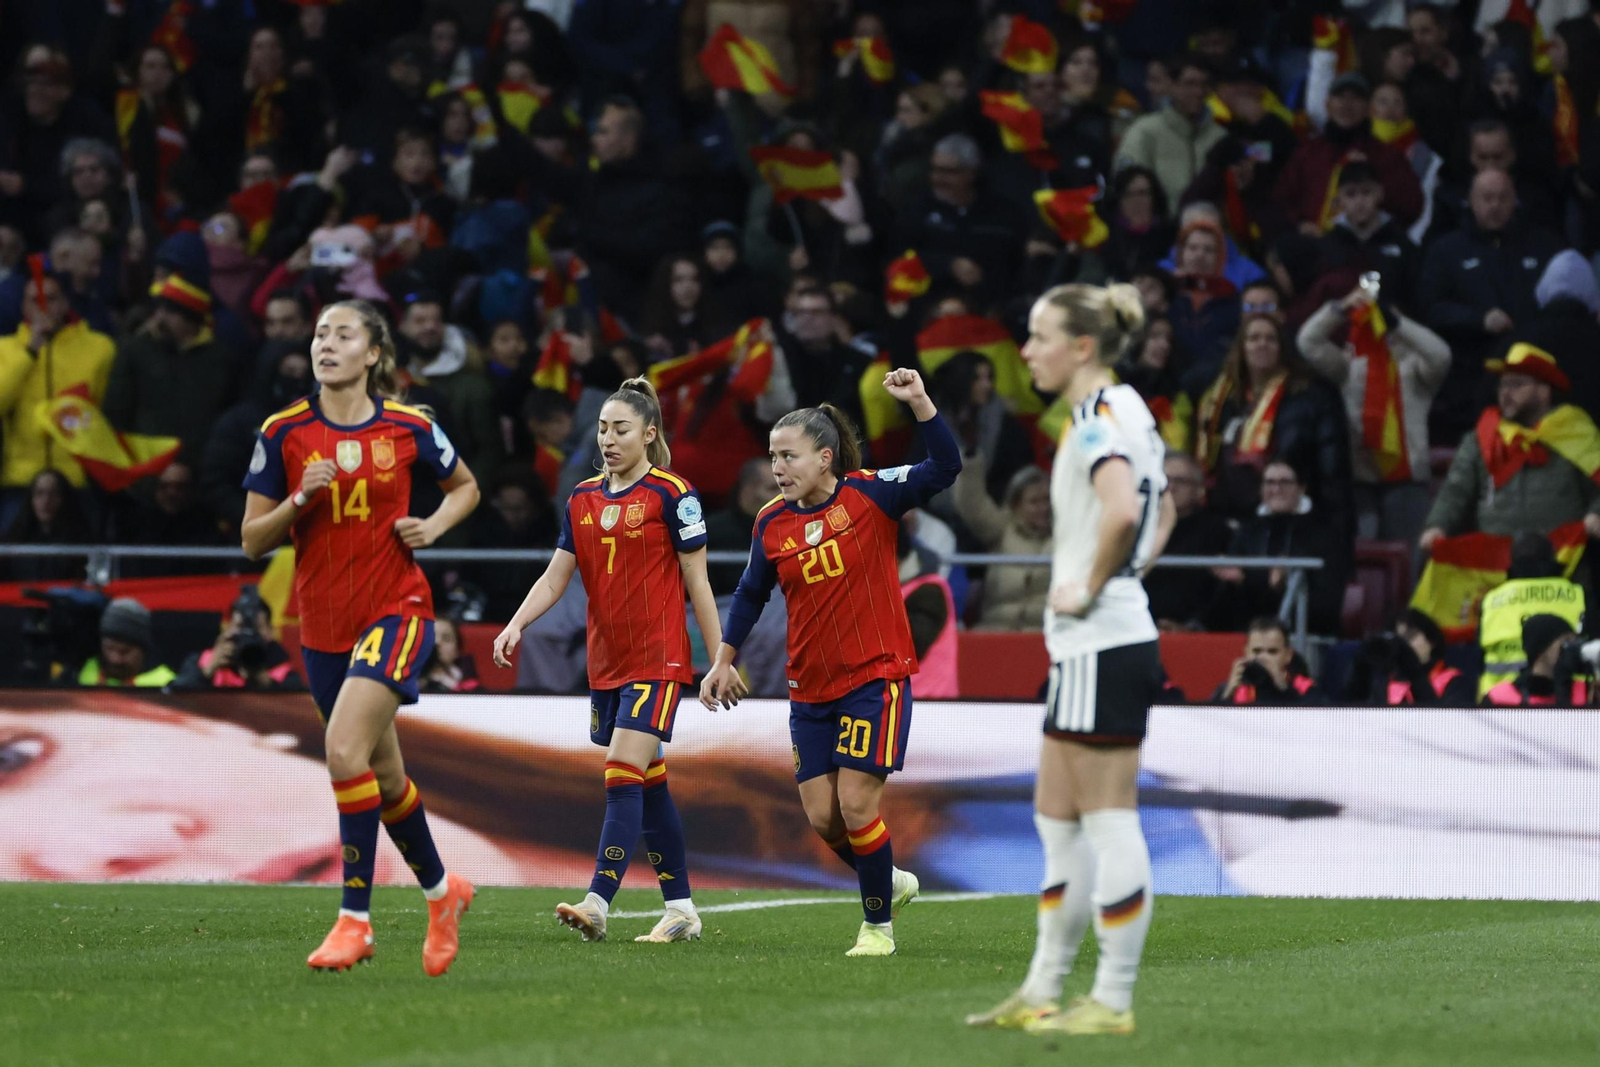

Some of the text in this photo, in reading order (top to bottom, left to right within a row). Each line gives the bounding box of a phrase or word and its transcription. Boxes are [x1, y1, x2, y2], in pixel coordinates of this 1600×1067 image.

[329, 478, 371, 524] 14
[601, 536, 617, 574] 7
[797, 538, 845, 584] 20
[631, 683, 652, 718] 7
[836, 715, 872, 758] 20
